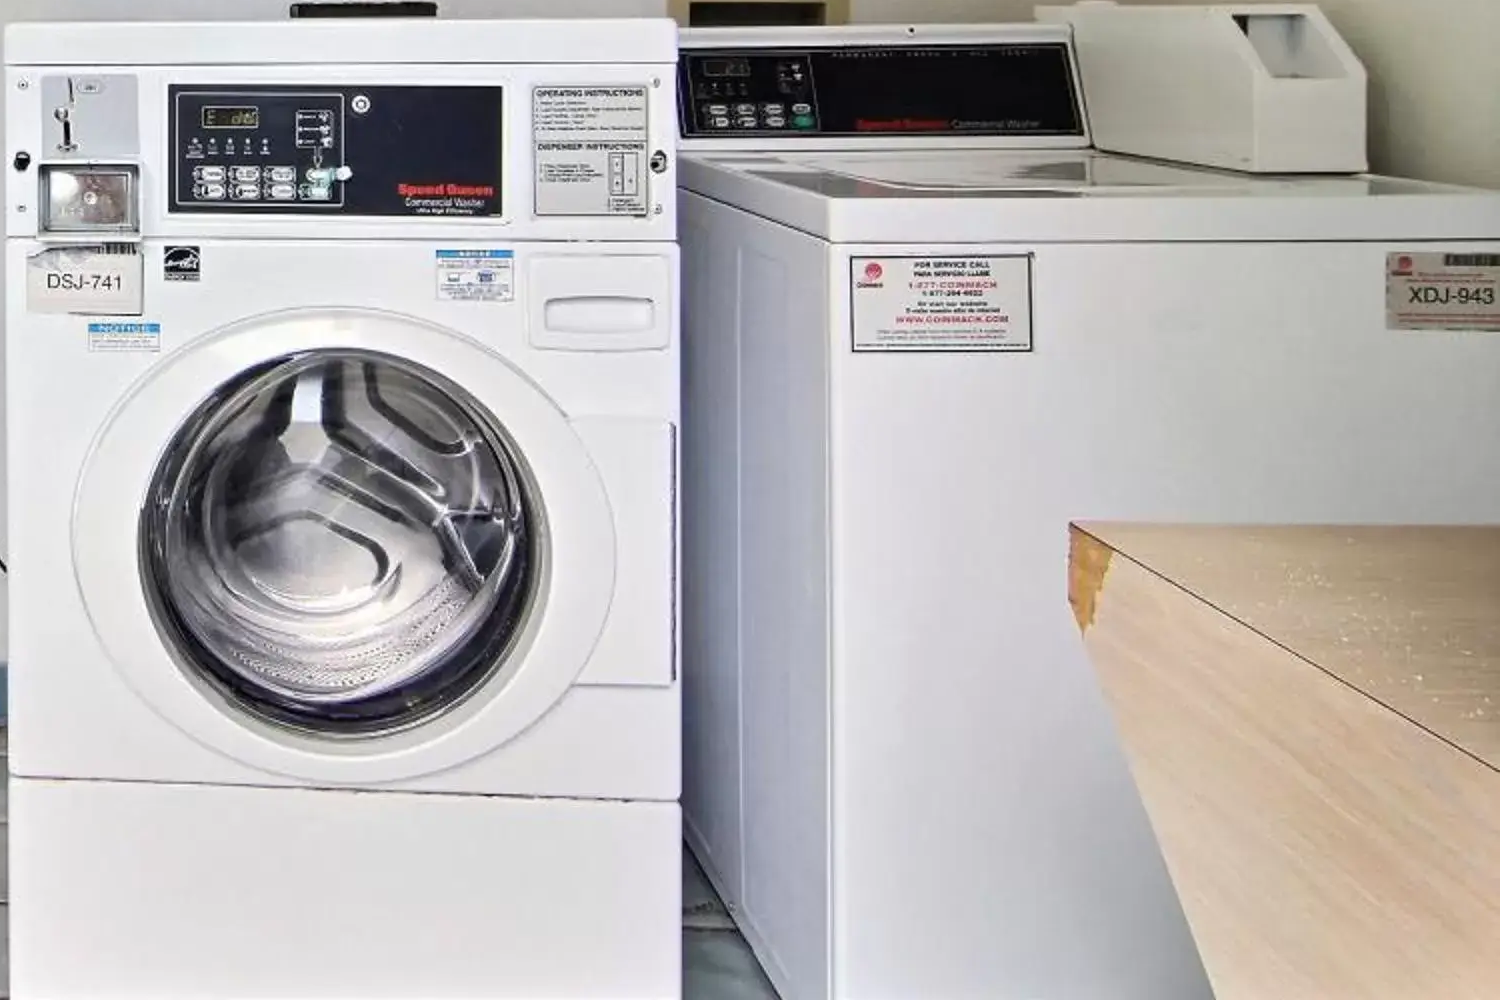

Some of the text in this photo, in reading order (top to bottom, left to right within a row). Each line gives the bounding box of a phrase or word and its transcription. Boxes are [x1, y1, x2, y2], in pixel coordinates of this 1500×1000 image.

[398, 184, 493, 196] Speed Queen
[405, 197, 453, 207] Commercial
[914, 261, 990, 269] FOR SERVICE CALL
[47, 273, 122, 290] DSJ-741
[1408, 286, 1495, 305] XDJ-943
